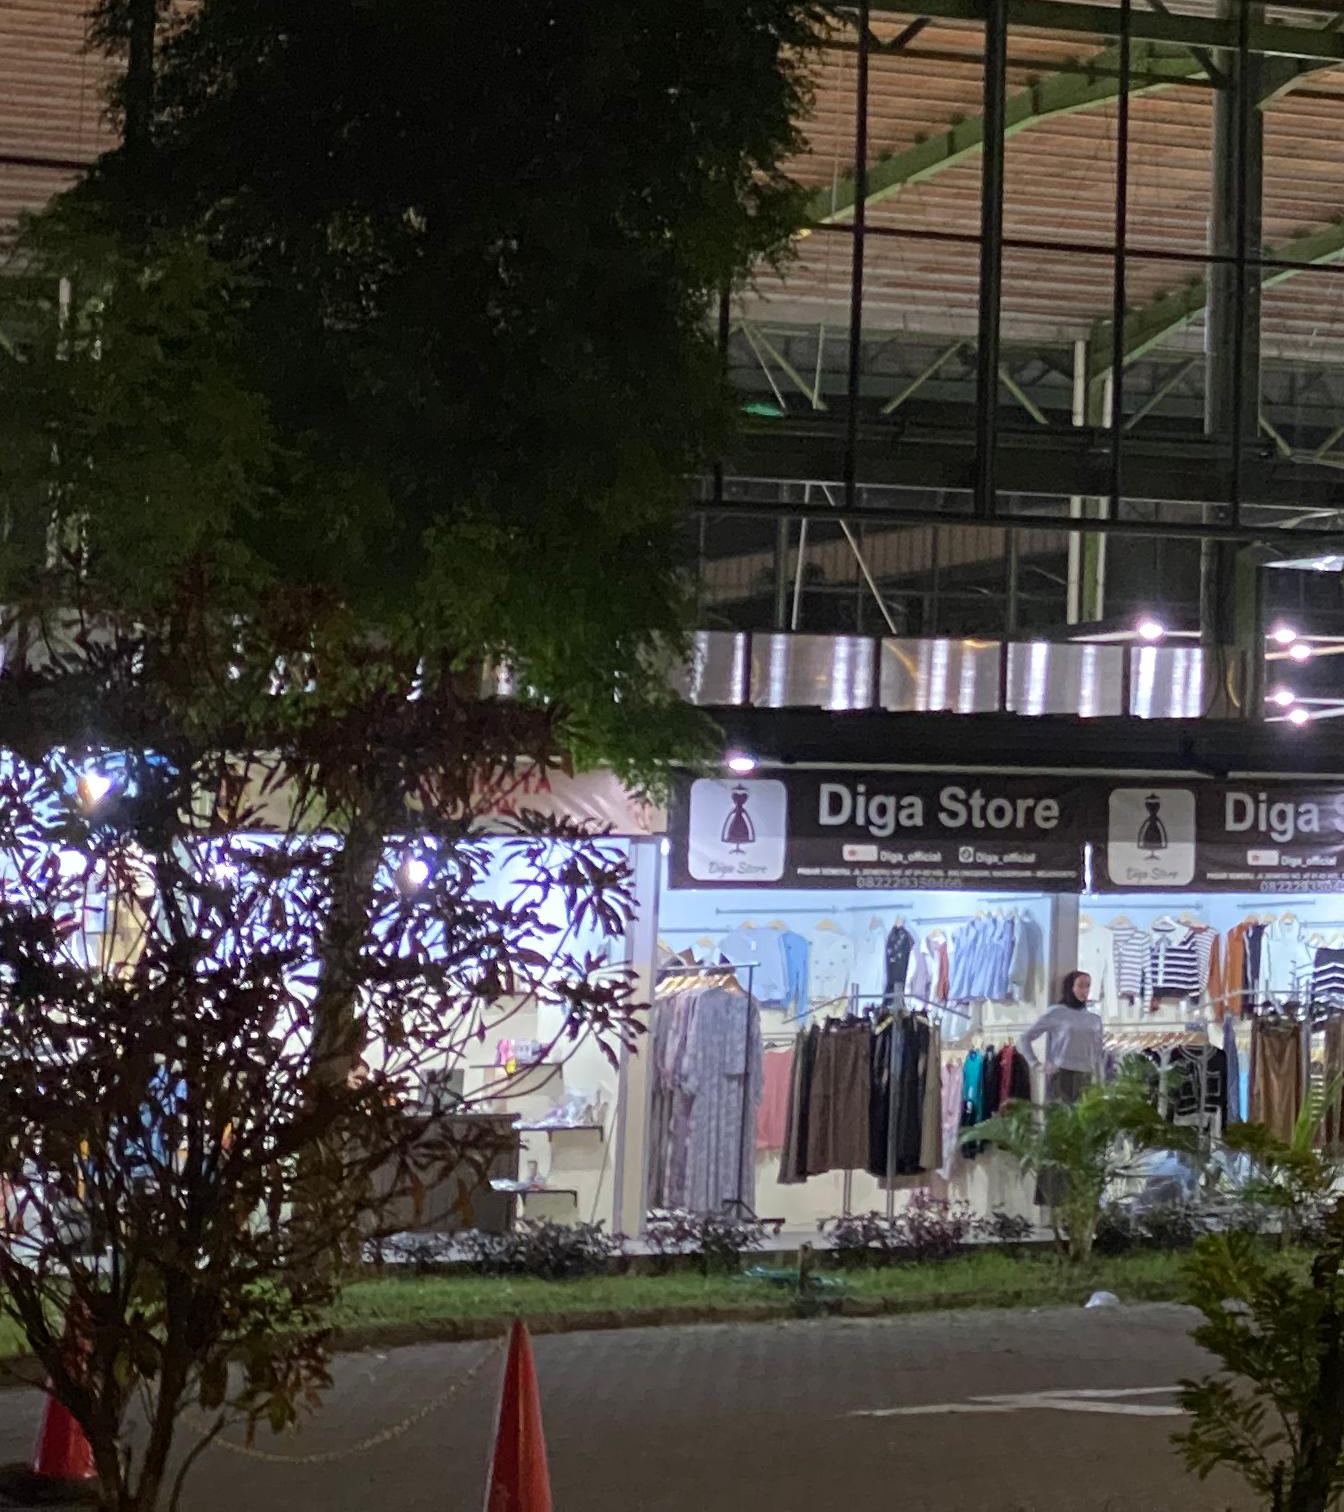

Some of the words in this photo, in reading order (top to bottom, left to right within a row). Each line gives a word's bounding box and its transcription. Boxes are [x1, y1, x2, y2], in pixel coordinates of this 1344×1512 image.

[818, 783, 923, 837] Diga
[938, 785, 1061, 829] Store
[1224, 792, 1320, 842] Diga
